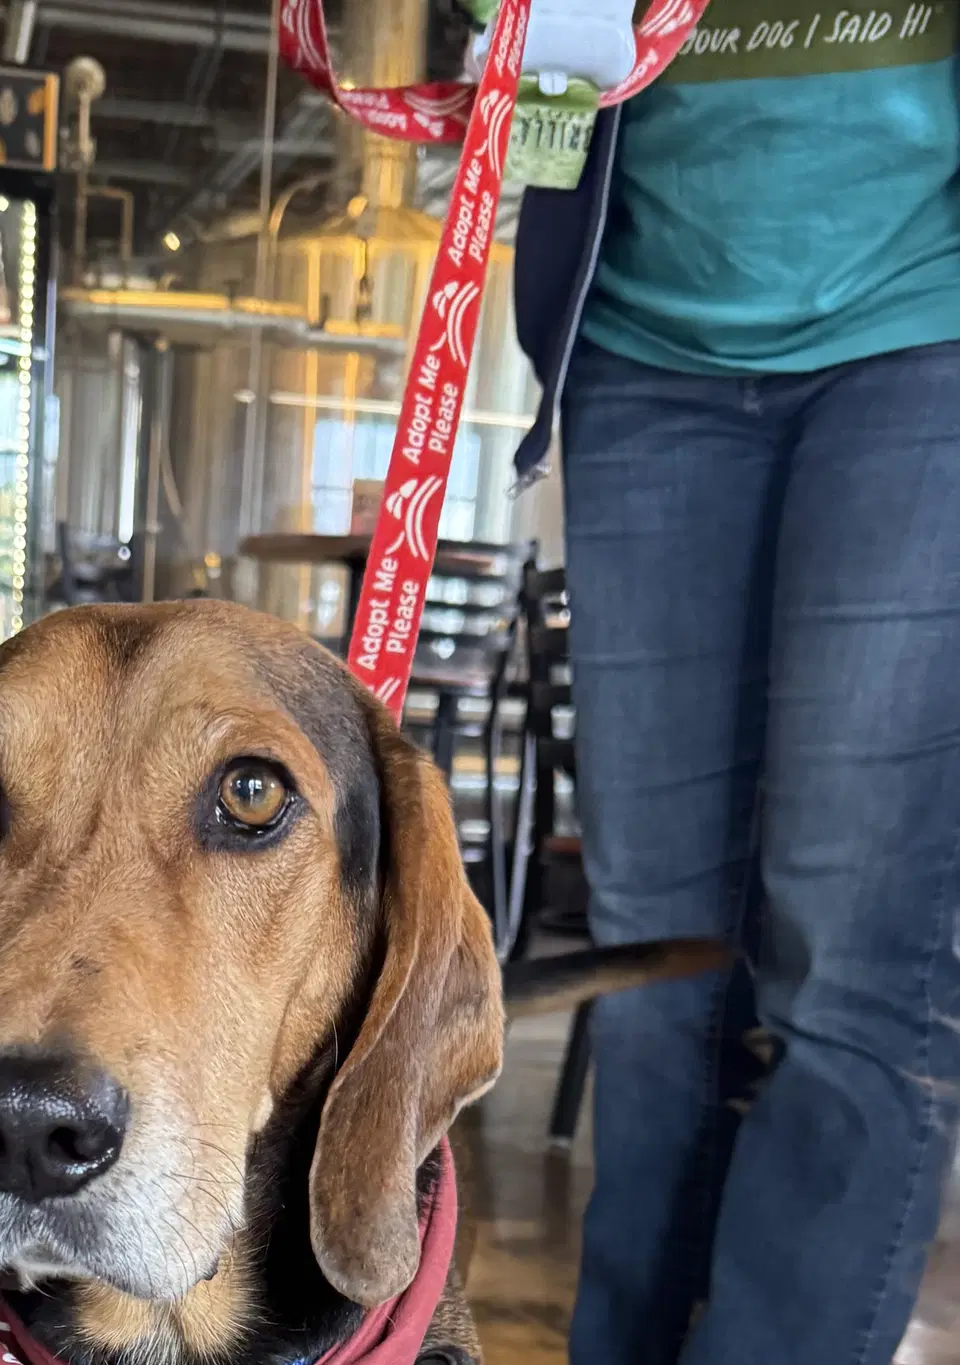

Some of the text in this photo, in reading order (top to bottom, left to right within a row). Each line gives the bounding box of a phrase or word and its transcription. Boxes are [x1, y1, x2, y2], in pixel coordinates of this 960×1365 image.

[746, 19, 799, 50] DOG
[803, 13, 821, 48] I
[823, 10, 892, 43] SAID
[898, 3, 932, 39] HI
[447, 158, 483, 268] Adopt Me
[468, 190, 495, 264] Please
[401, 354, 441, 465] Adopt Me
[428, 382, 459, 454] Please
[356, 557, 399, 671] Adopt Me
[386, 579, 420, 654] Please
